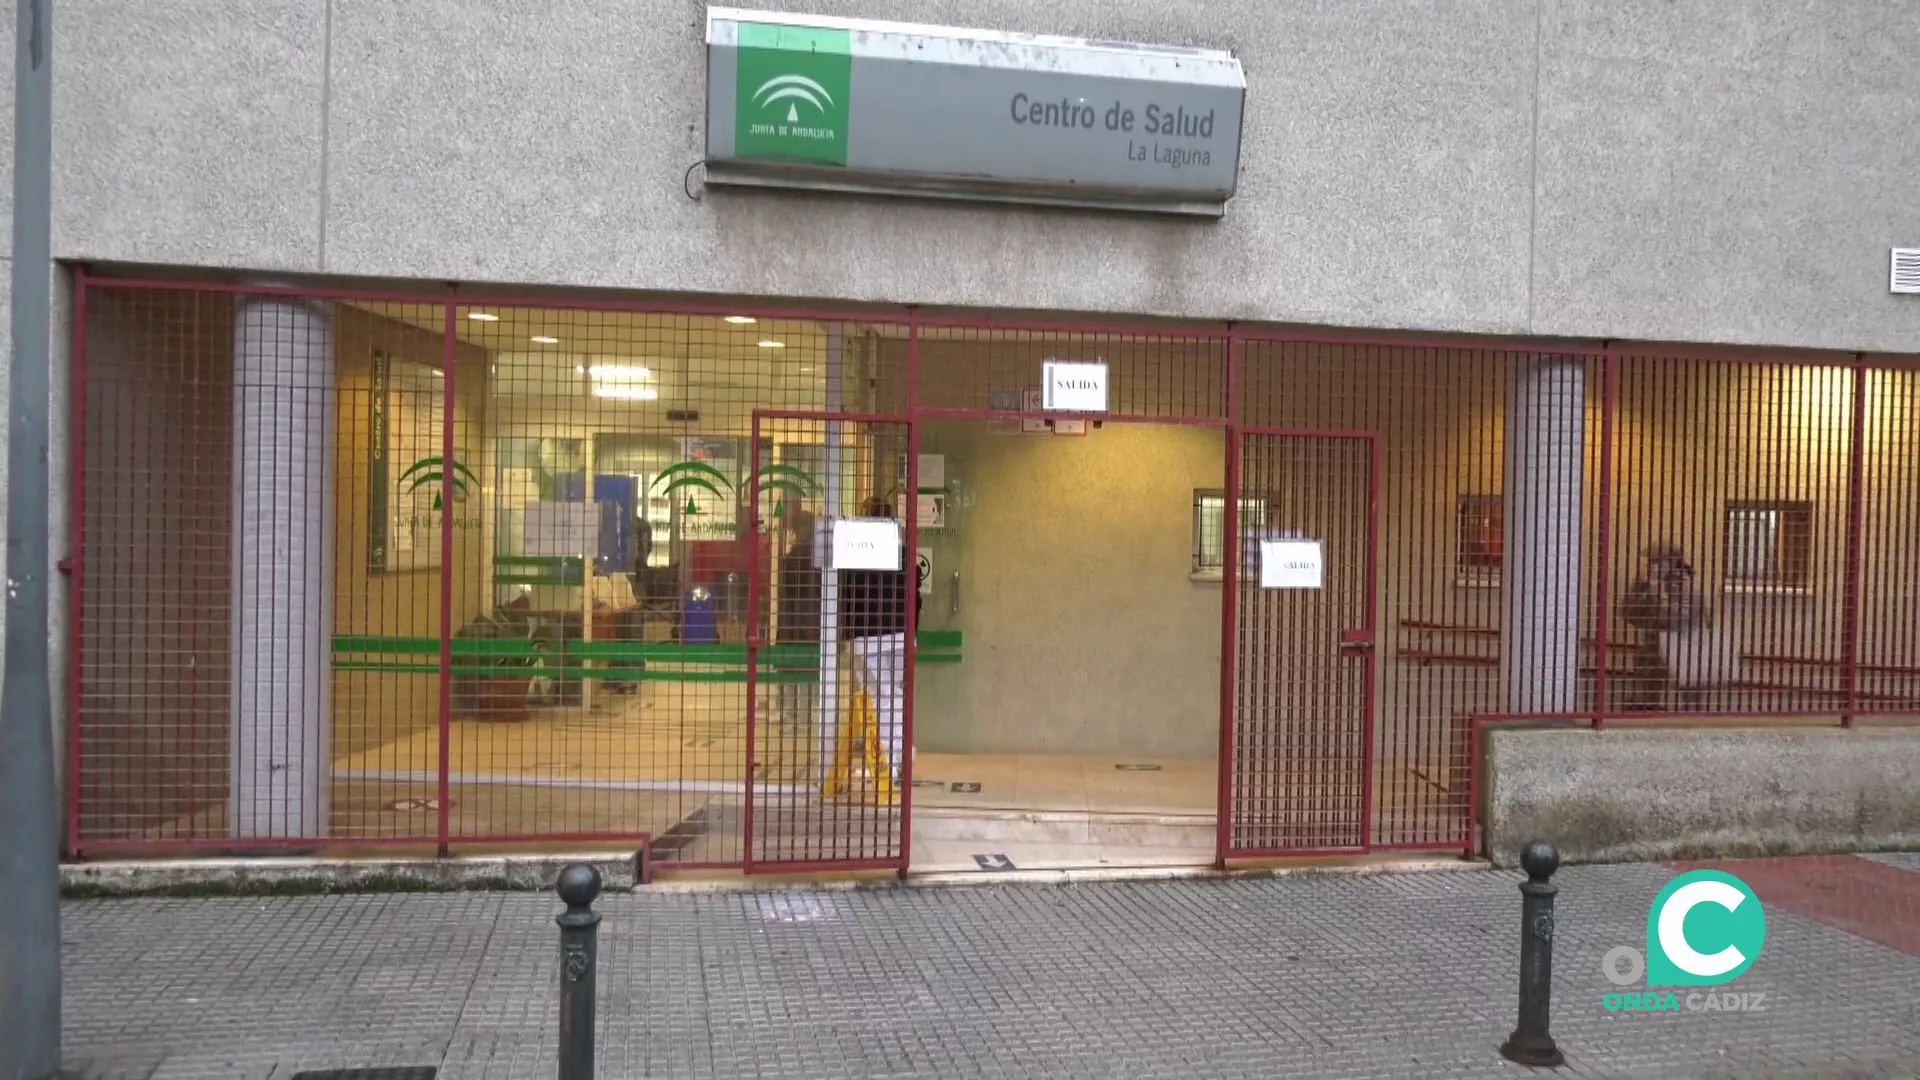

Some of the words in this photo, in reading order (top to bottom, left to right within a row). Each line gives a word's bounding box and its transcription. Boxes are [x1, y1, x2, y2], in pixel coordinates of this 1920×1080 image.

[1010, 91, 1096, 129] Centro
[1104, 100, 1136, 132] de
[1144, 103, 1216, 138] Salud
[749, 123, 776, 137] JUNTA
[778, 125, 789, 137] DE
[1128, 140, 1147, 162] La
[1153, 141, 1211, 169] Laguna
[1057, 380, 1098, 390] SALIDA
